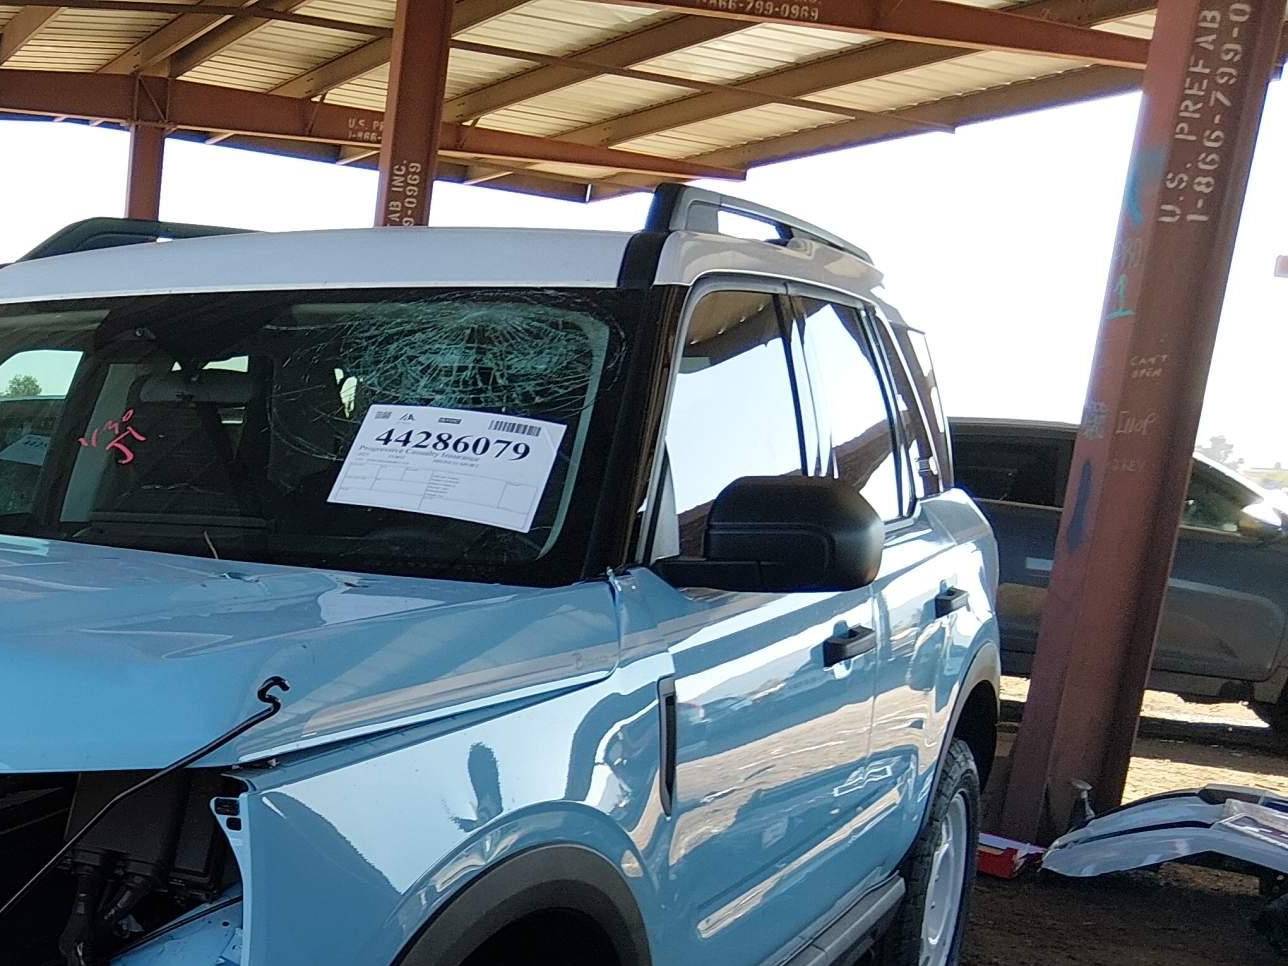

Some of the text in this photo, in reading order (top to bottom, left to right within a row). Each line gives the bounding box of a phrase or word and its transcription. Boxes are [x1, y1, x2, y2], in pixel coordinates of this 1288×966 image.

[1158, 9, 1221, 223] U.S. PREFAB
[392, 159, 407, 192] INC.
[375, 427, 531, 462] 44286079
